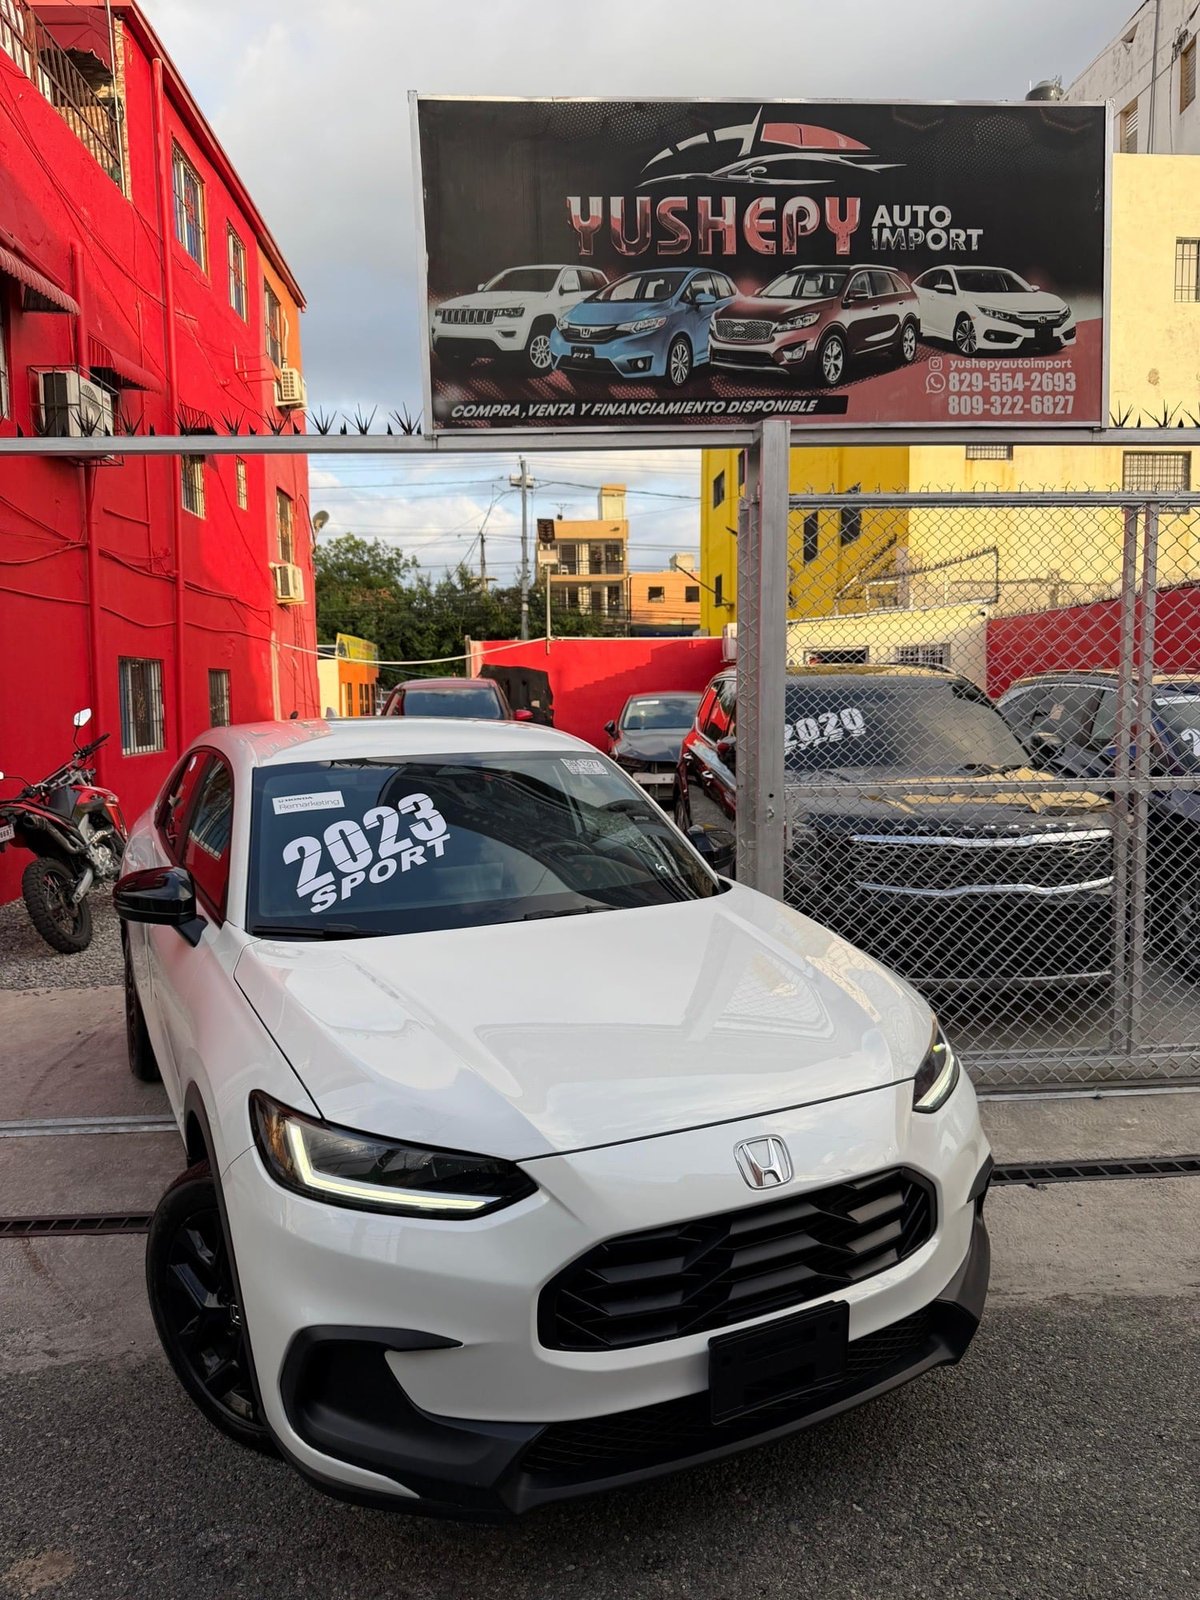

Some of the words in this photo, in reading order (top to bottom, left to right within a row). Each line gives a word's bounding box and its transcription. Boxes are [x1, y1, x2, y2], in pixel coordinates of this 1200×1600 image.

[566, 196, 861, 255] YUSHEPY
[871, 205, 952, 228] AUTO
[871, 228, 984, 251] IMPORT
[950, 358, 1072, 371] yushepyautoimport
[948, 372, 1077, 392] 829-554-2693
[579, 403, 592, 416] Y
[591, 401, 727, 416] FINANCIAMIENTO
[726, 399, 818, 414] DISPONIBLE
[948, 395, 1075, 415] 809-322-6827
[279, 799, 340, 811] Remarketing
[283, 793, 447, 898] 2023
[310, 833, 451, 914] SPORT
